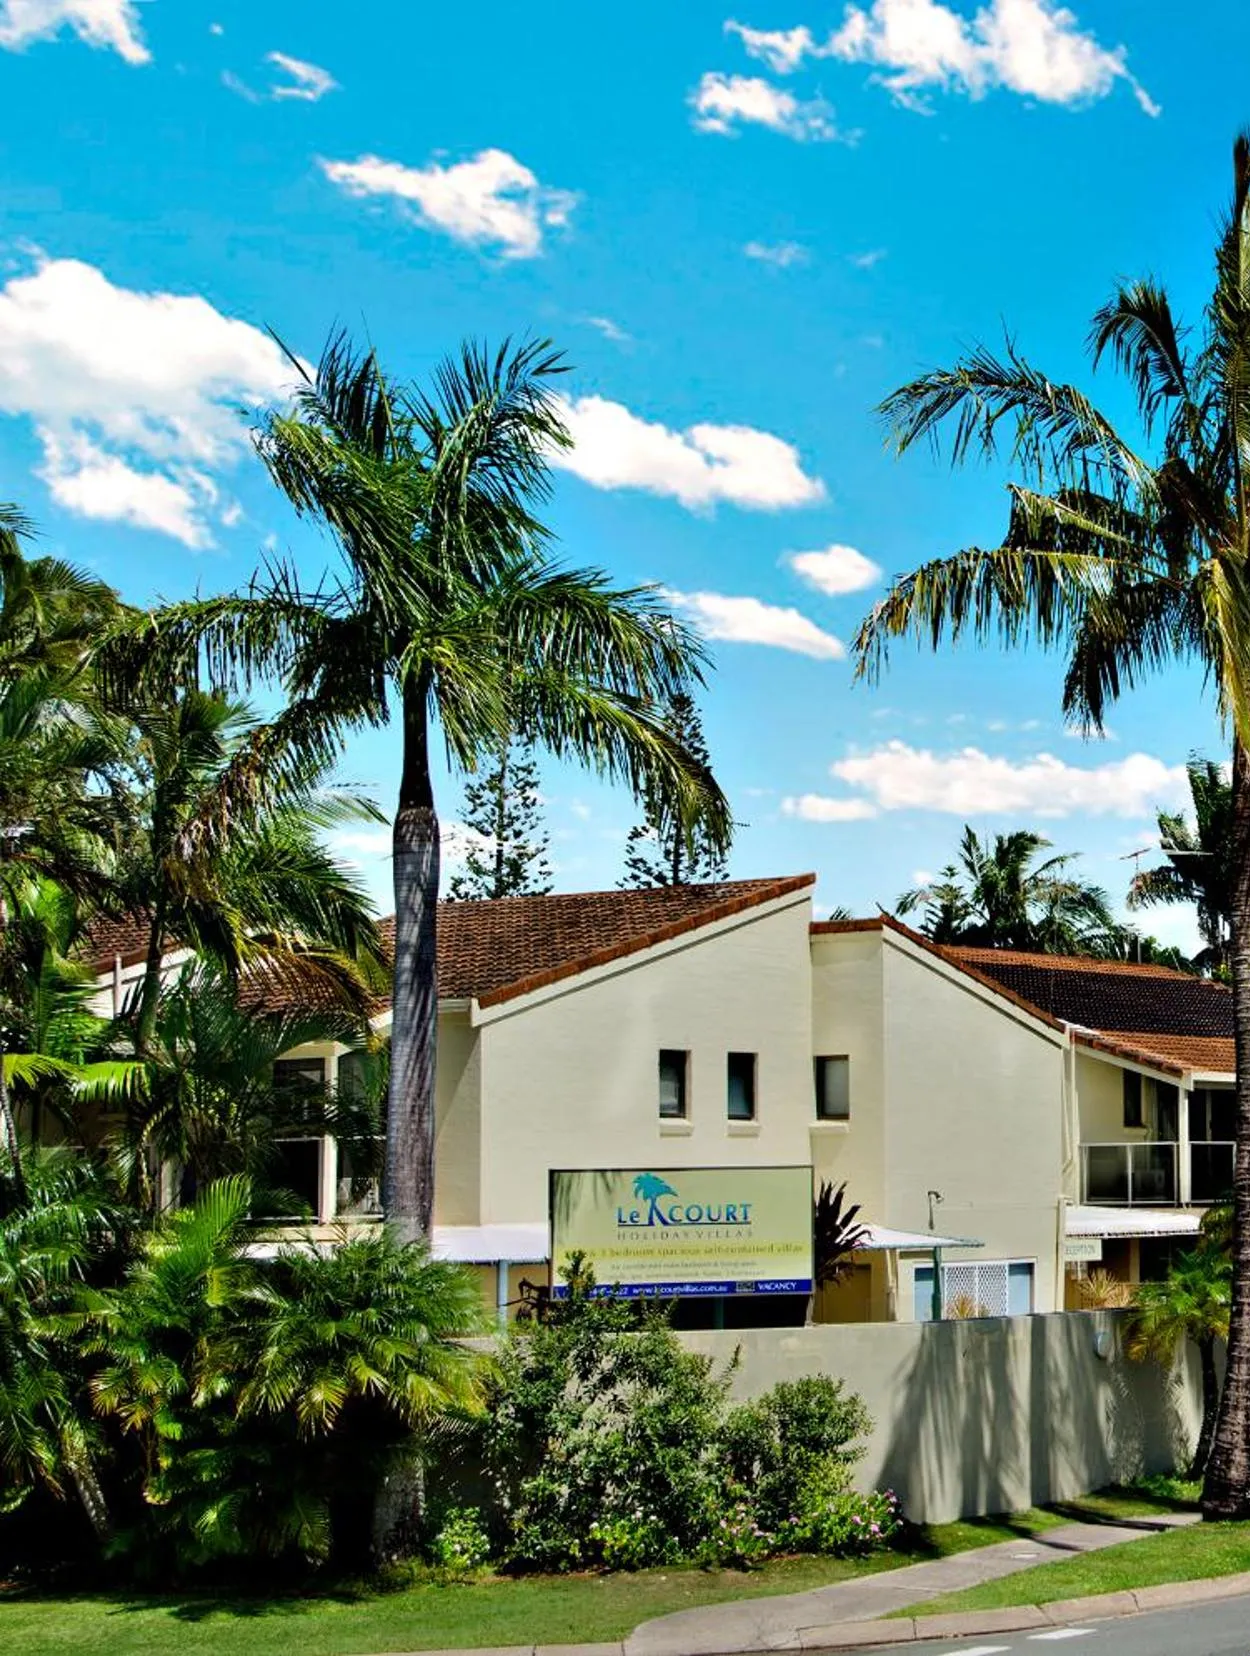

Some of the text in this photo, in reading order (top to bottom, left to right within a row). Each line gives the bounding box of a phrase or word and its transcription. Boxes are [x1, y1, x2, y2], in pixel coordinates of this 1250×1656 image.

[617, 1202, 752, 1224] Le COURT
[617, 1228, 753, 1241] HOLIDAY VILLAS
[757, 1281, 797, 1291] VACANCY
